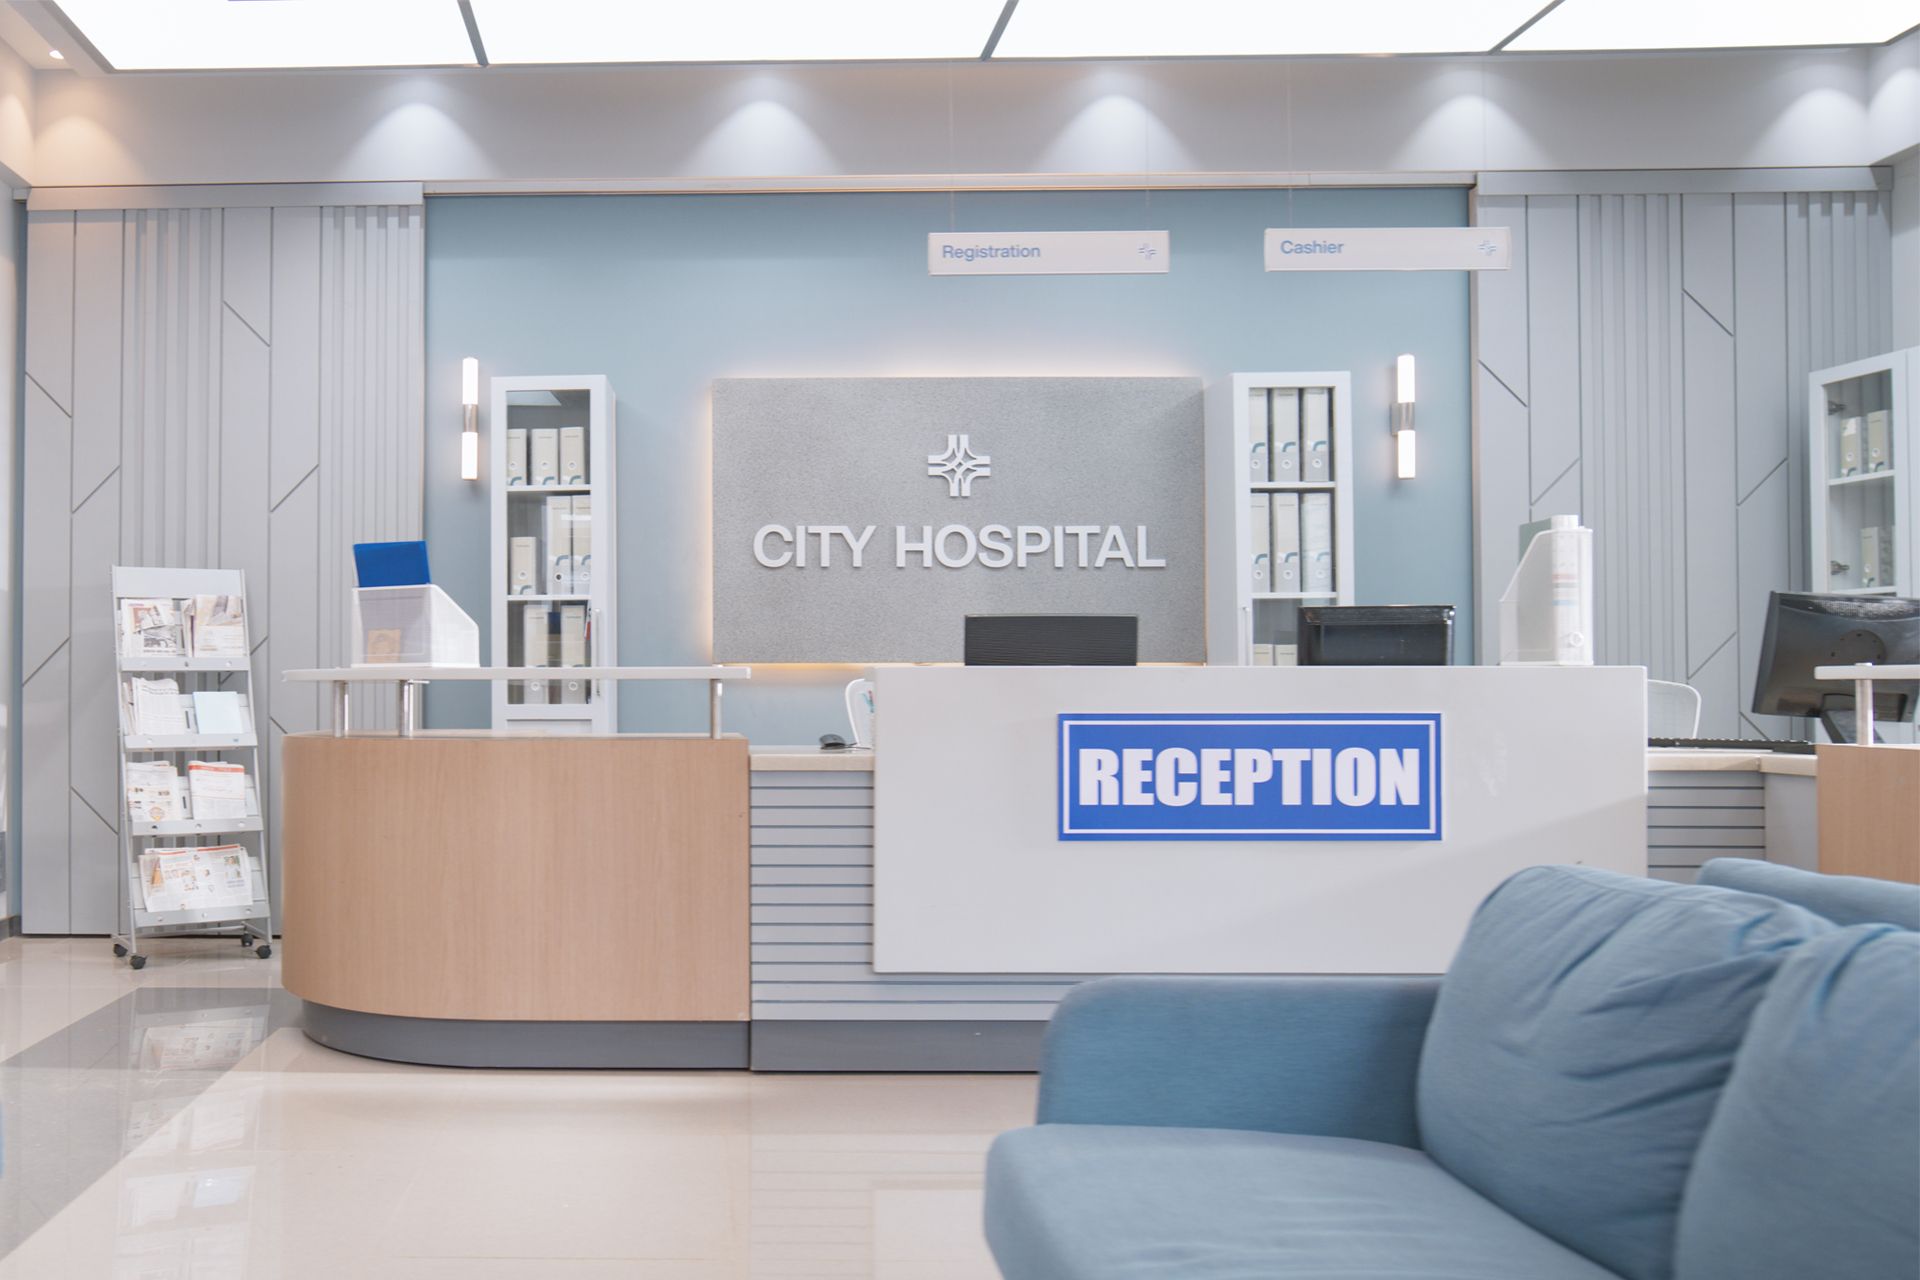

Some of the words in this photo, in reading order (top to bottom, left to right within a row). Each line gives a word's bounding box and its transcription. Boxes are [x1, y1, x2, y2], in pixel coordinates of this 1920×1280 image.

[942, 244, 1041, 262] Registration
[1280, 240, 1344, 255] Cashier
[753, 524, 877, 568] CITY
[895, 524, 1167, 568] HOSPITAL
[1079, 747, 1420, 807] RECEPTION
